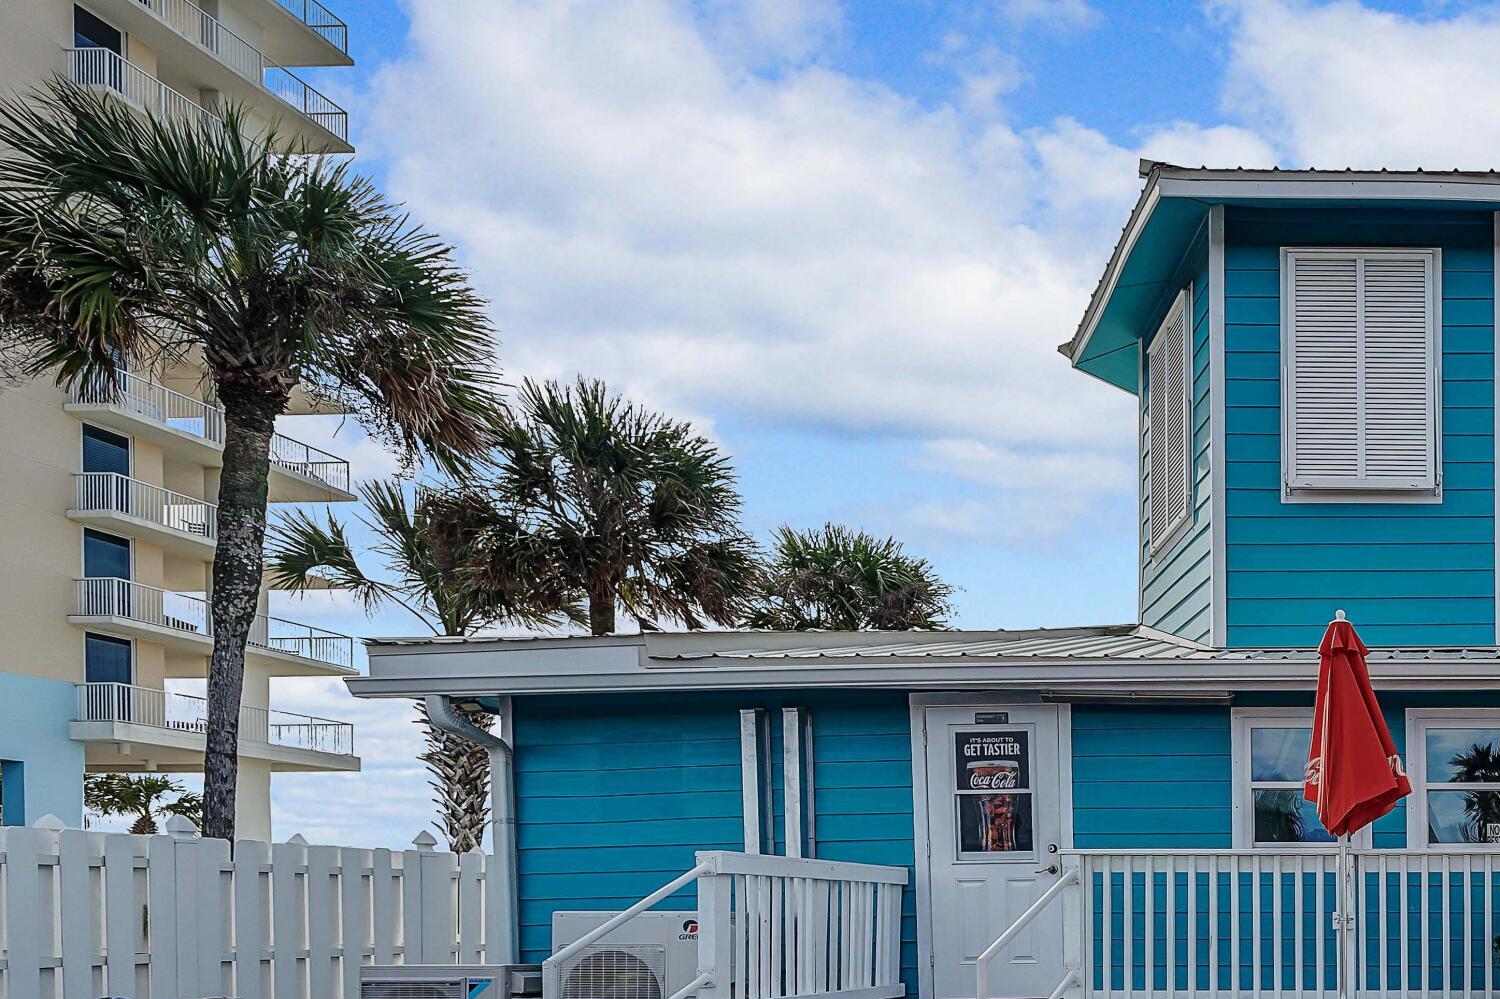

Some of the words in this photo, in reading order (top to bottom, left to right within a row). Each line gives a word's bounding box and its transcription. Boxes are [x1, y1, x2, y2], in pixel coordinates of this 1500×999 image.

[964, 744, 981, 756] GET
[983, 743, 1020, 756] TASTIER
[970, 771, 1017, 789] Coca-Cola
[1490, 824, 1500, 836] NO
